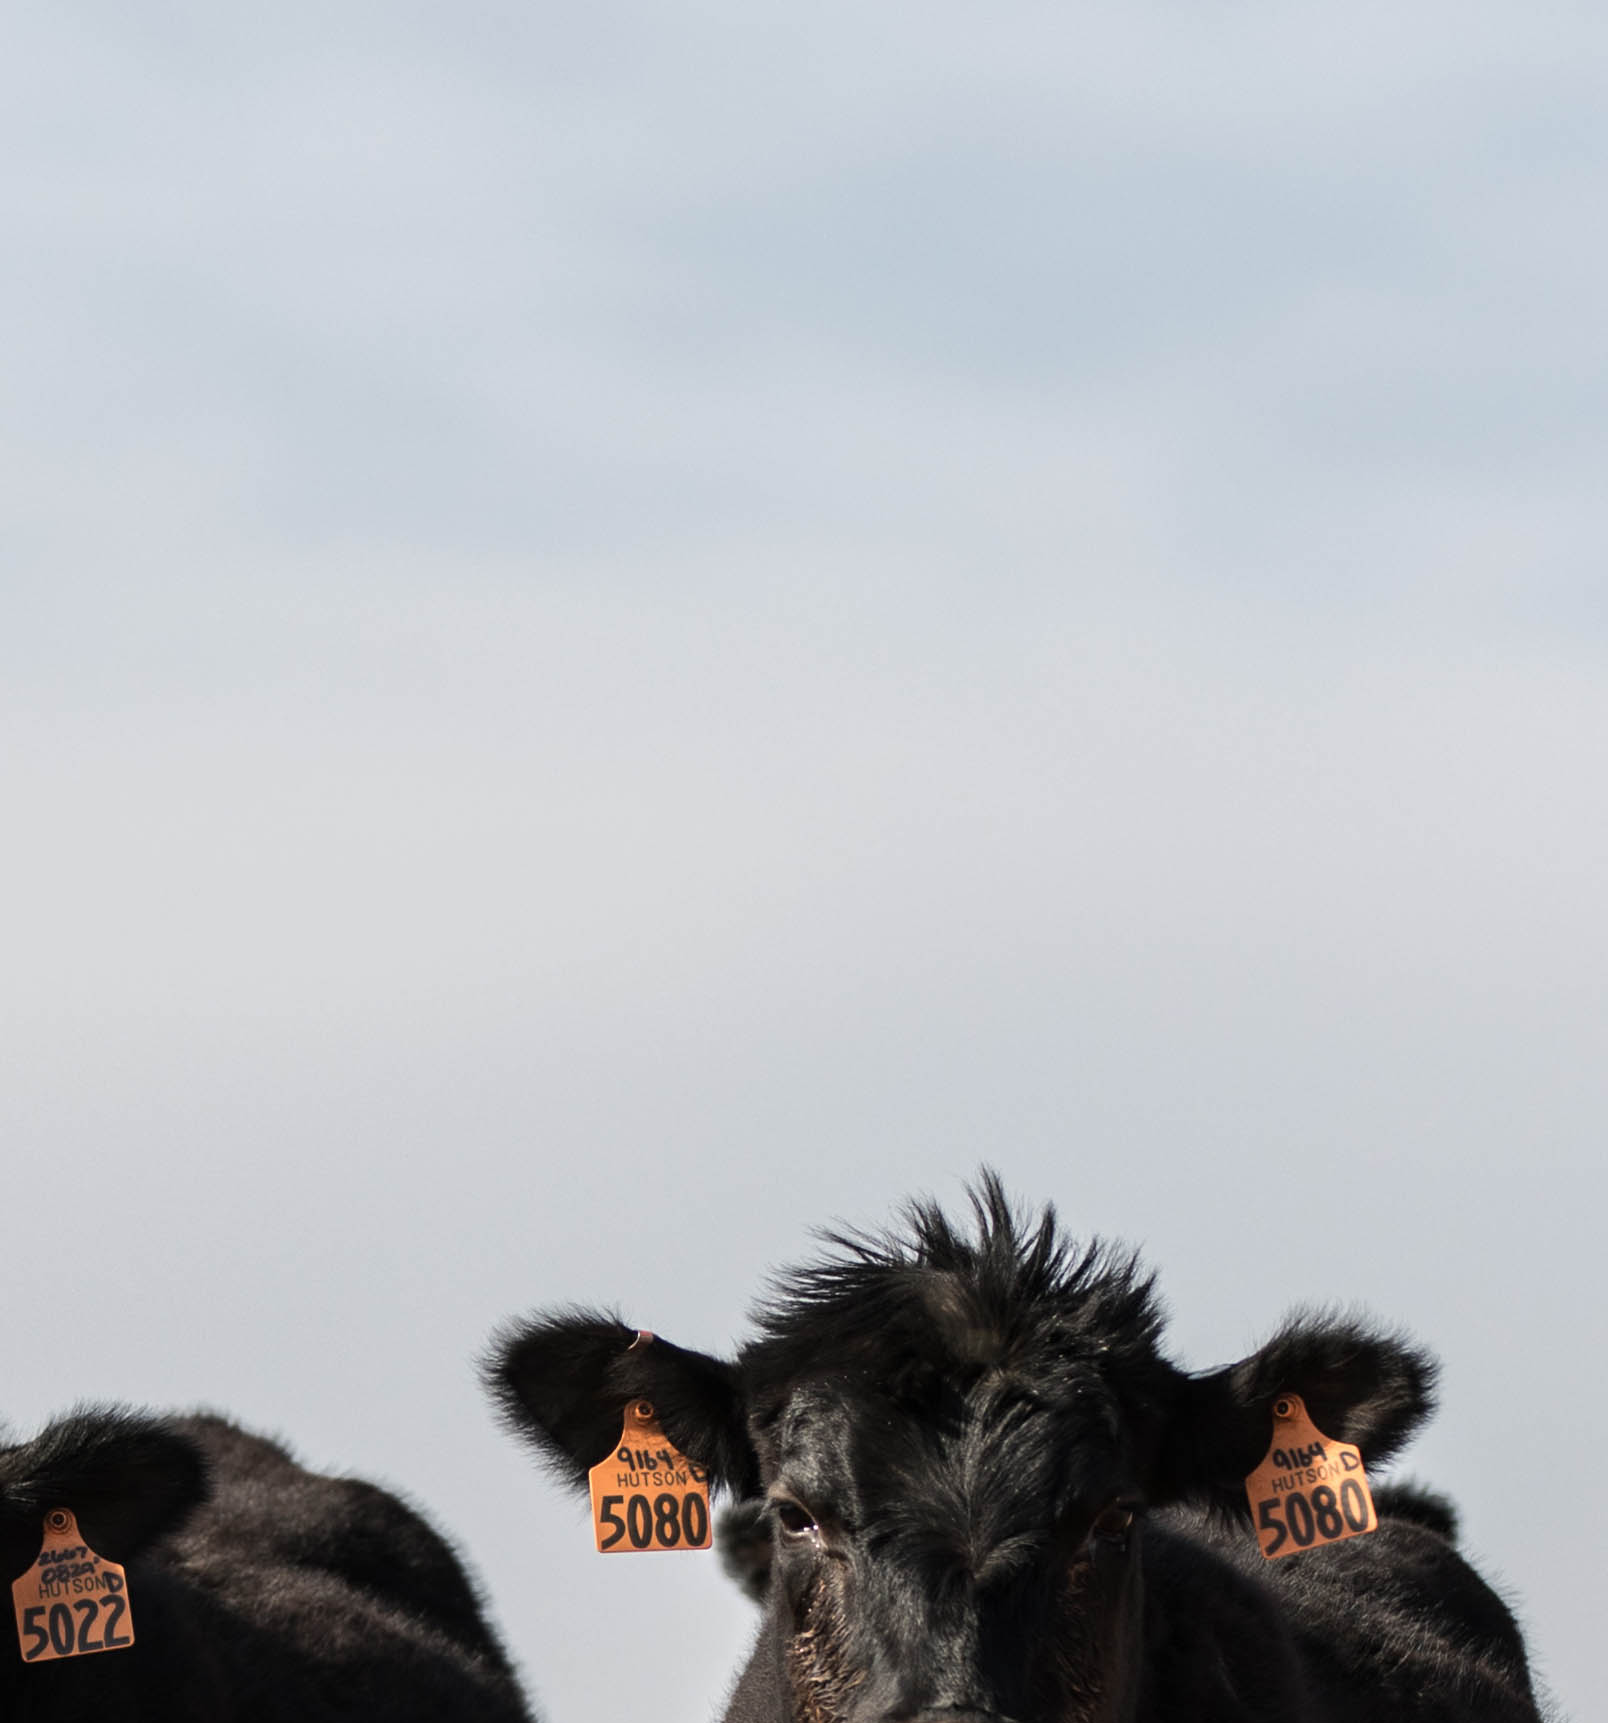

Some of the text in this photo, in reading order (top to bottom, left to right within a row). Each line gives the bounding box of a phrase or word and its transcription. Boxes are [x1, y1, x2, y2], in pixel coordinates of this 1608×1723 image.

[617, 1447, 674, 1471] 9164
[1273, 1442, 1328, 1471] 9164
[1340, 1451, 1360, 1472] D
[617, 1471, 687, 1487] HUTSON
[1272, 1462, 1340, 1493] HUTSON
[600, 1492, 707, 1550] 5080
[1258, 1478, 1368, 1556] 5080
[39, 1576, 108, 1599] HUTSON
[102, 1571, 123, 1593] D
[23, 1594, 130, 1660] 5022
